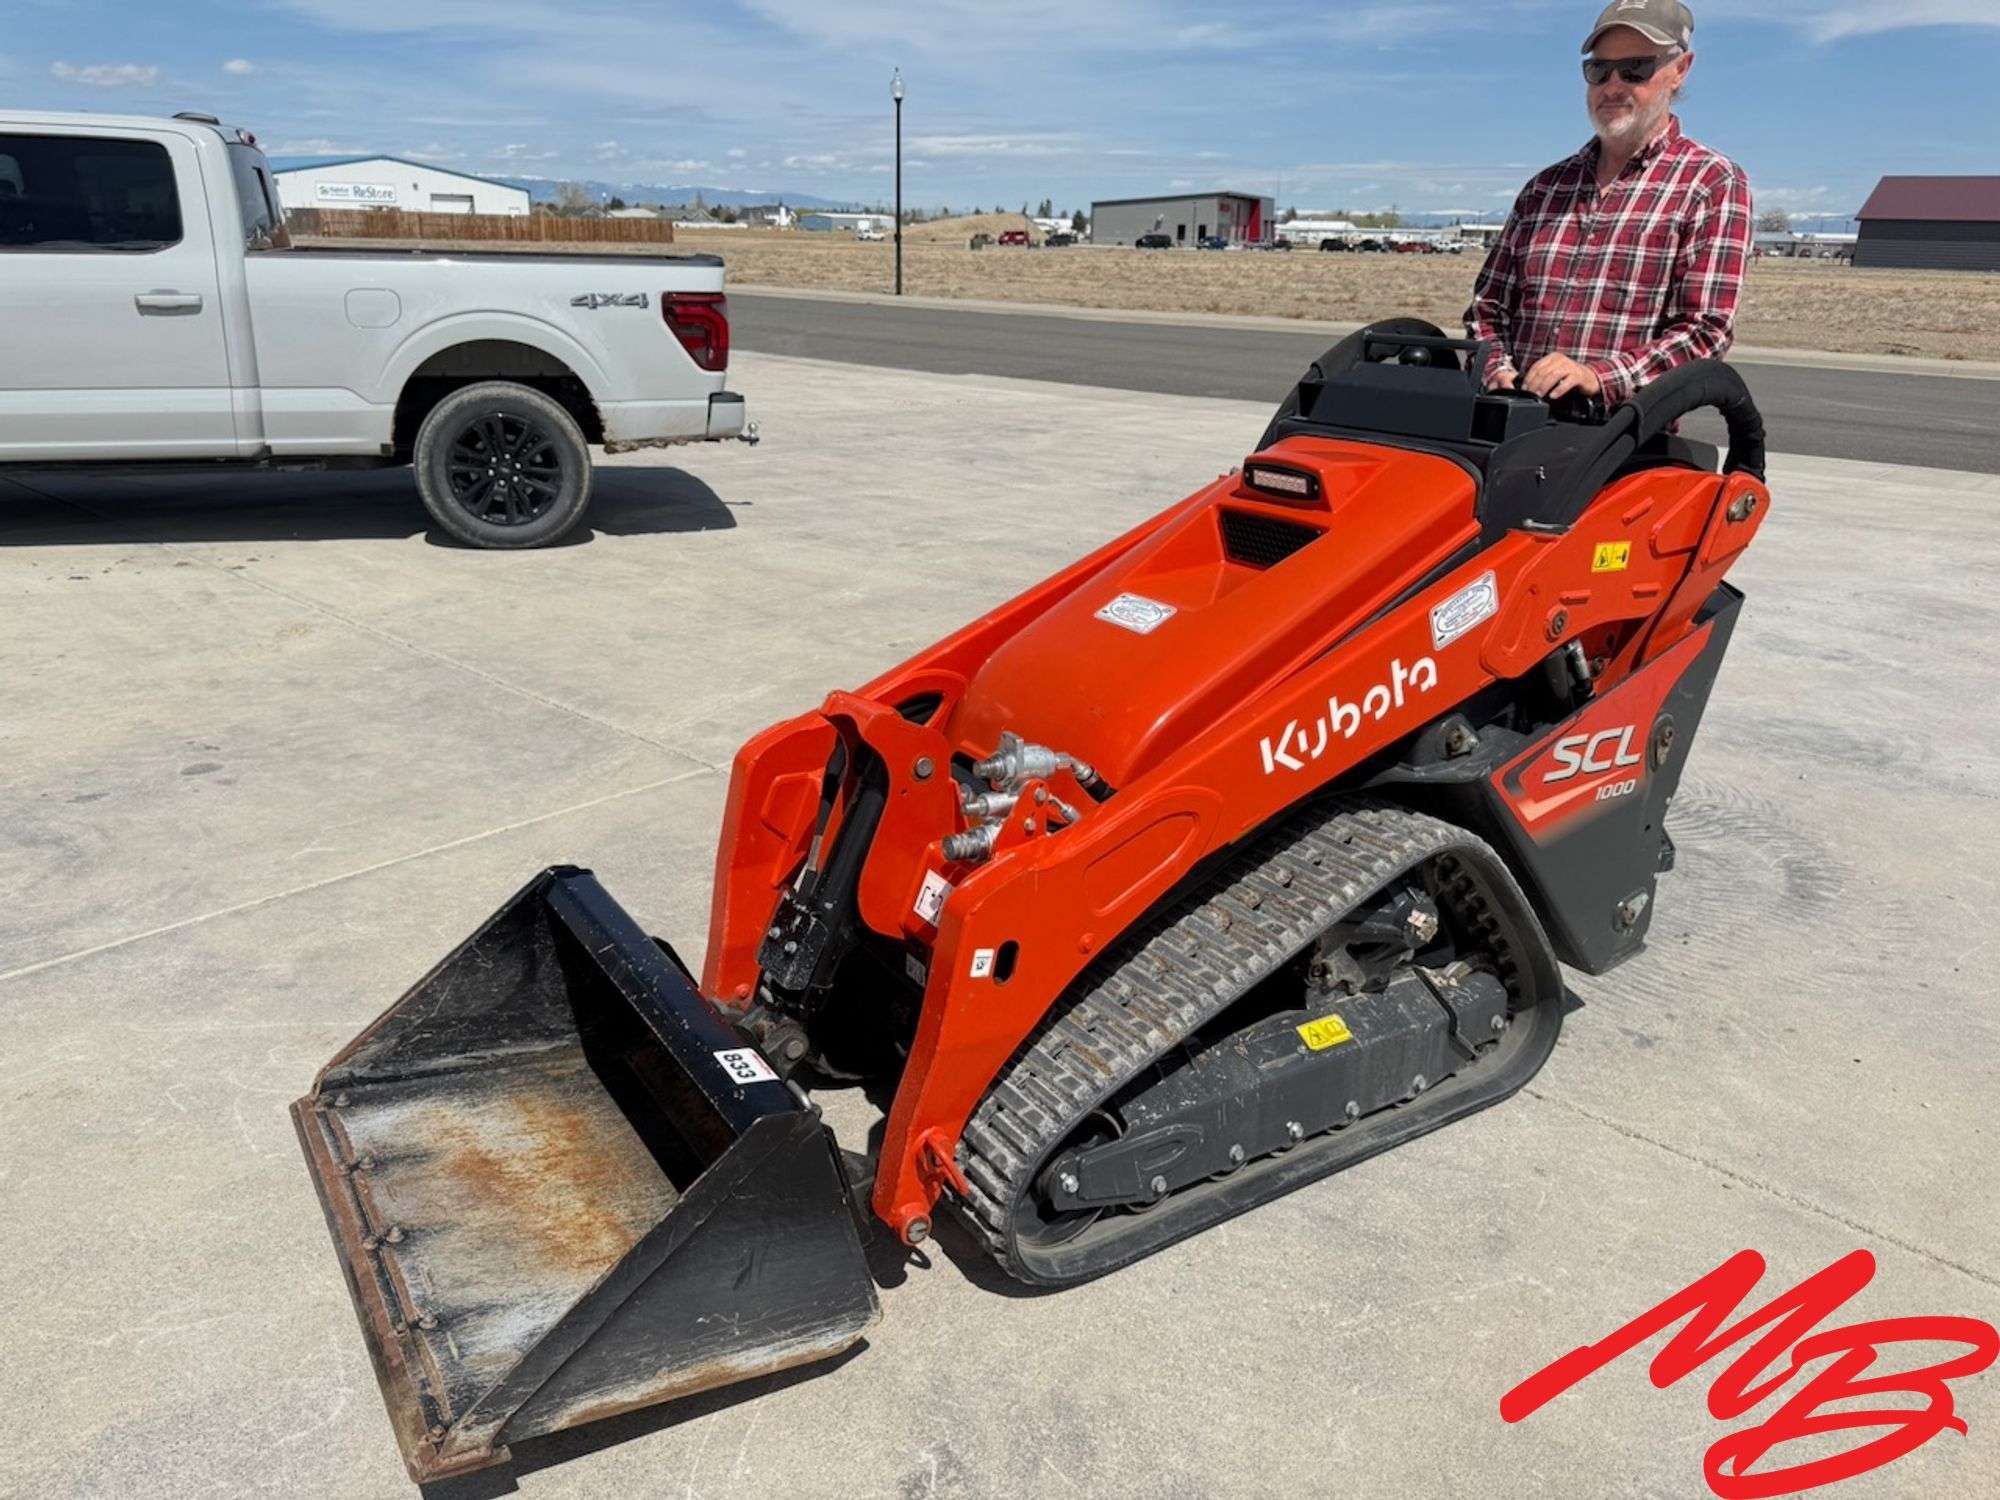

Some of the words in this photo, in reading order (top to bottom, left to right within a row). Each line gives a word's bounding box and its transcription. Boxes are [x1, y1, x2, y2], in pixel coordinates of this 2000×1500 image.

[1259, 656, 1438, 775] Kubota
[1542, 725, 1641, 783] SCL
[1595, 779, 1636, 801] 1000
[723, 1053, 757, 1078] 833
